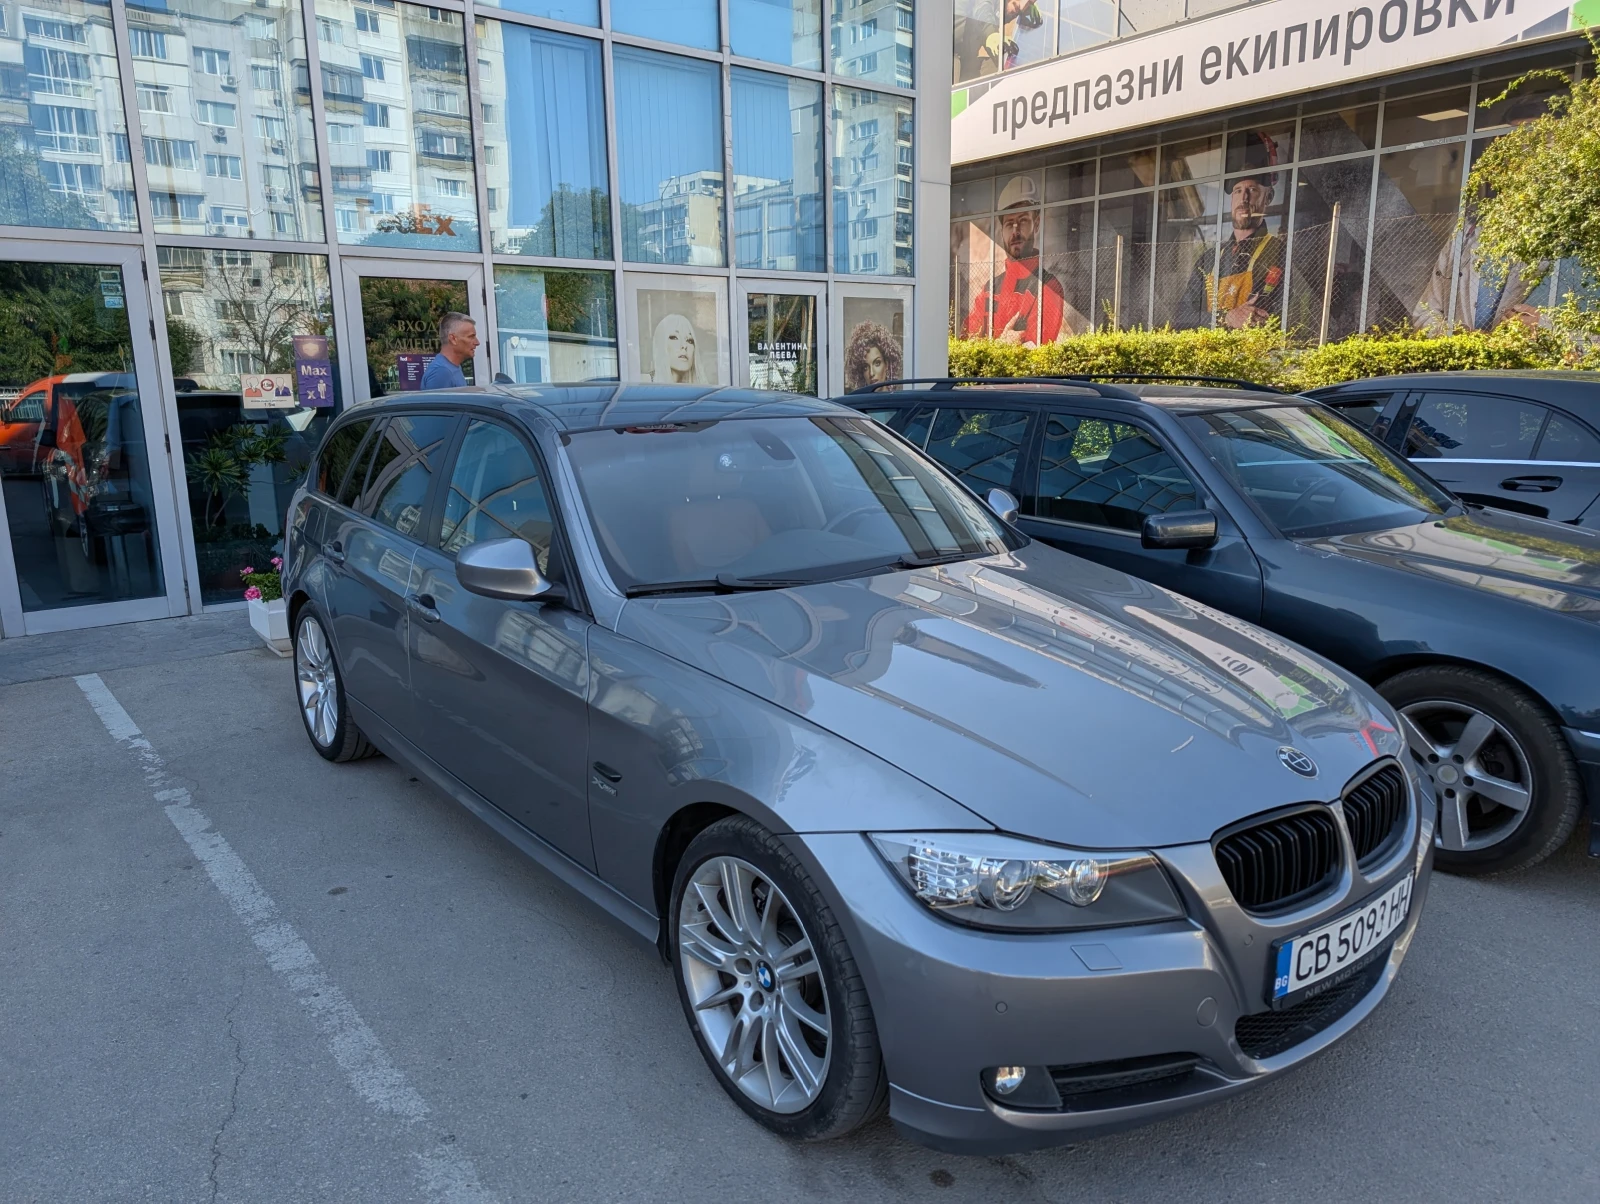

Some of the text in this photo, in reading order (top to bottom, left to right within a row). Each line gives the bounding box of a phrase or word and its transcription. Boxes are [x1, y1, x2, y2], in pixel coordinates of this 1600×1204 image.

[993, 54, 1184, 140] предпазни
[397, 320, 439, 334] ВХОД
[385, 338, 441, 350] КЛИЕНТ
[757, 342, 808, 350] ВАЛЕНТИНА
[769, 351, 797, 359] ПЕЕВА
[301, 365, 327, 376] Max
[1274, 975, 1288, 990] BG
[1295, 933, 1331, 981] CB
[1336, 900, 1387, 963] 5093
[1388, 877, 1410, 929] HH
[1305, 980, 1332, 998] NEW
